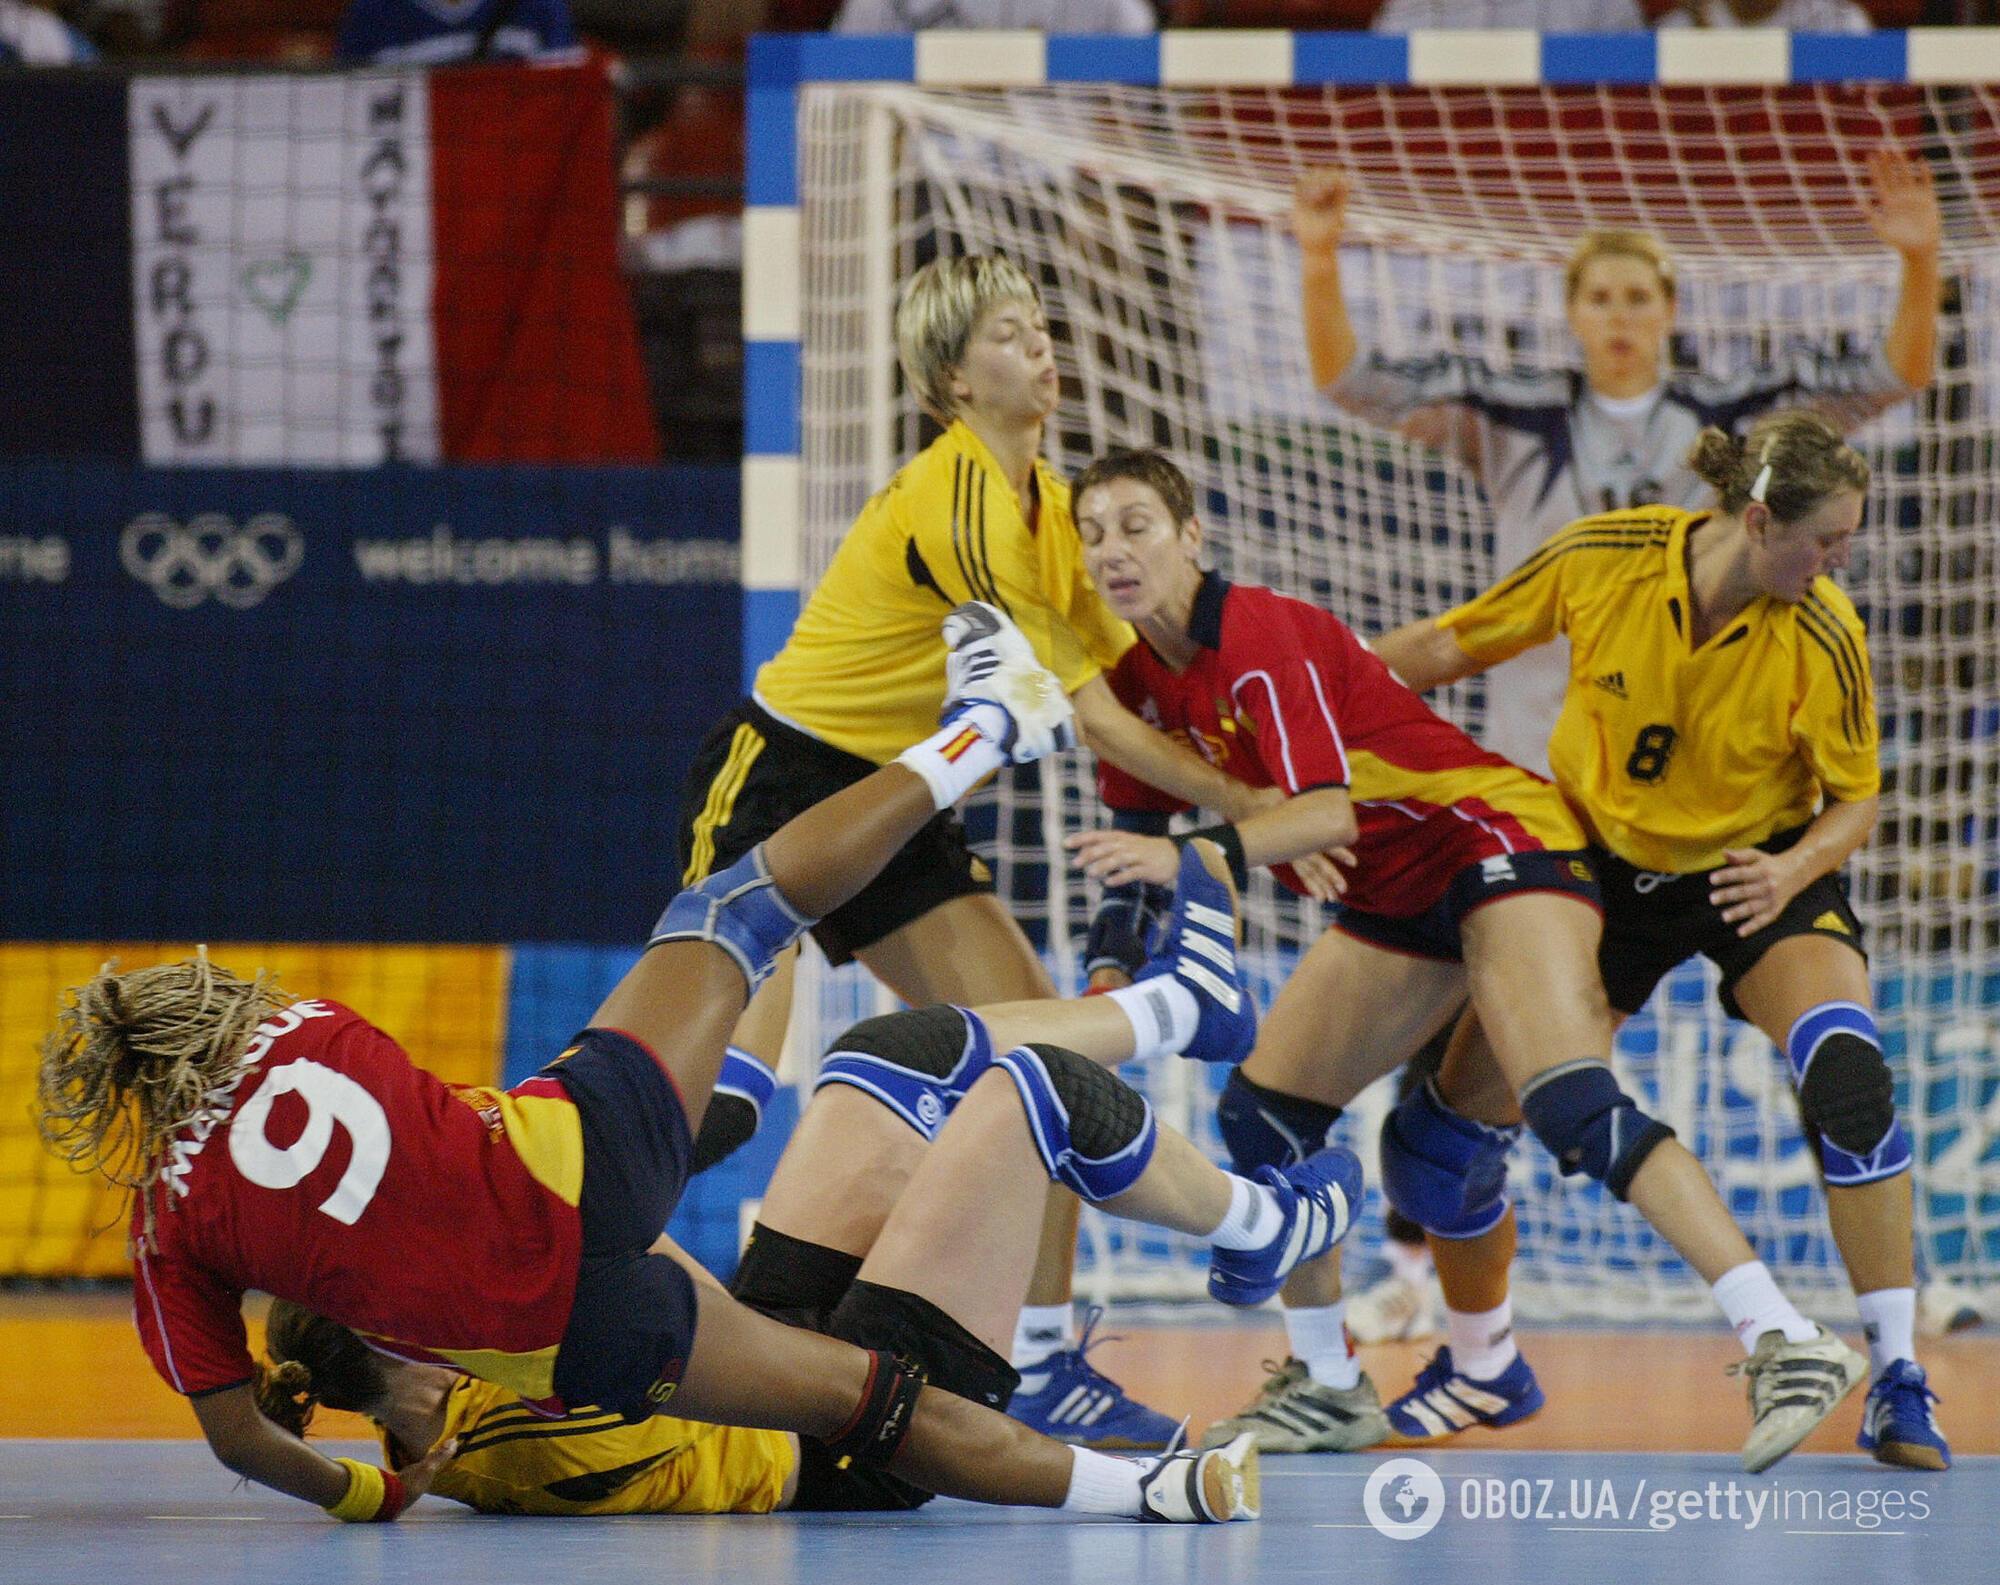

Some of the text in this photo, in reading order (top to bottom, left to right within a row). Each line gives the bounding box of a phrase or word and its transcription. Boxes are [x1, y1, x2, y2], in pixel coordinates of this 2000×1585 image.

[354, 522, 742, 586] welcome hom
[1625, 724, 1677, 784] 8
[228, 1056, 392, 1226] 9
